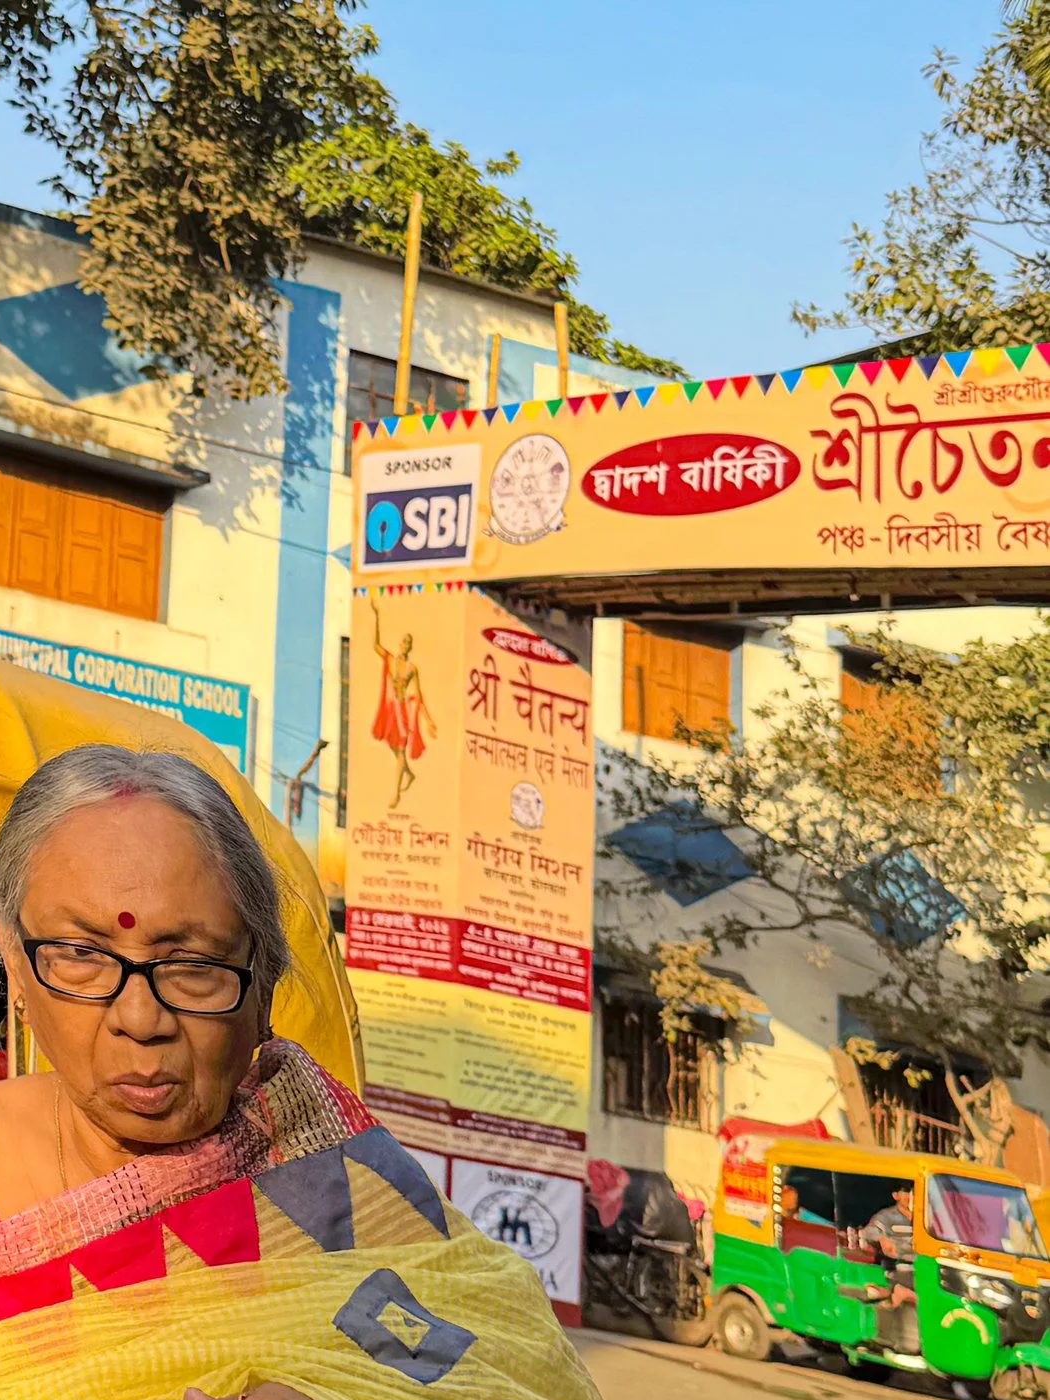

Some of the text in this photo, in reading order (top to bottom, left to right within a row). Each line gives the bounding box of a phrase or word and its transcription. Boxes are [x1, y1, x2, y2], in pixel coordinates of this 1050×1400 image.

[385, 456, 453, 476] SPONSOR
[590, 444, 788, 502] দ্বাদশ বার্ষিকী
[401, 493, 471, 551] SBI
[74, 652, 181, 704] CORPORATION
[182, 676, 243, 719] SCHOOL
[467, 653, 589, 746] श्री चैतन्य
[533, 743, 555, 784] एवं
[529, 845, 583, 884] मिशन
